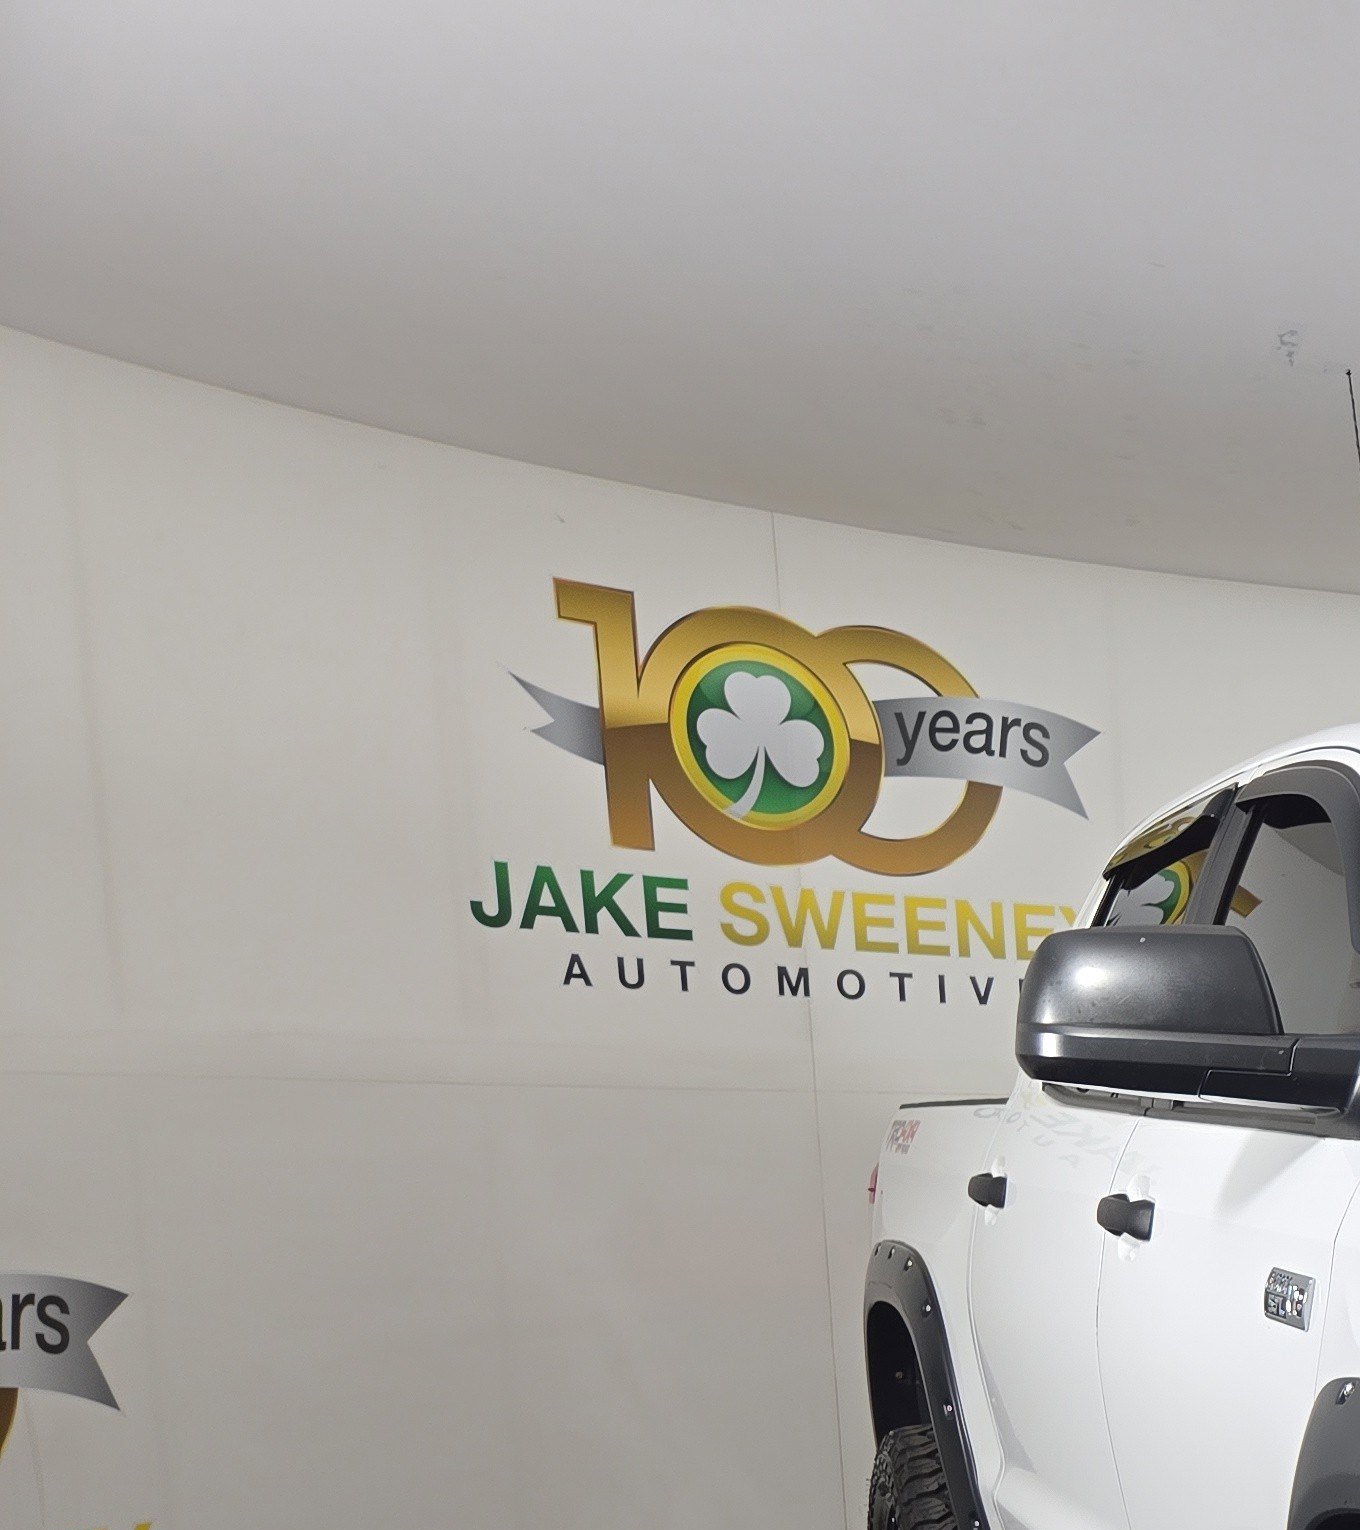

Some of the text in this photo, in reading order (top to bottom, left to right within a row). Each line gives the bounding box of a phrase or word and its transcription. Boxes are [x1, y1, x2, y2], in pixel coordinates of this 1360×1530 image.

[895, 708, 1051, 768] years
[470, 860, 694, 941] JAKE
[563, 953, 1025, 1005] AUTOMOTIV
